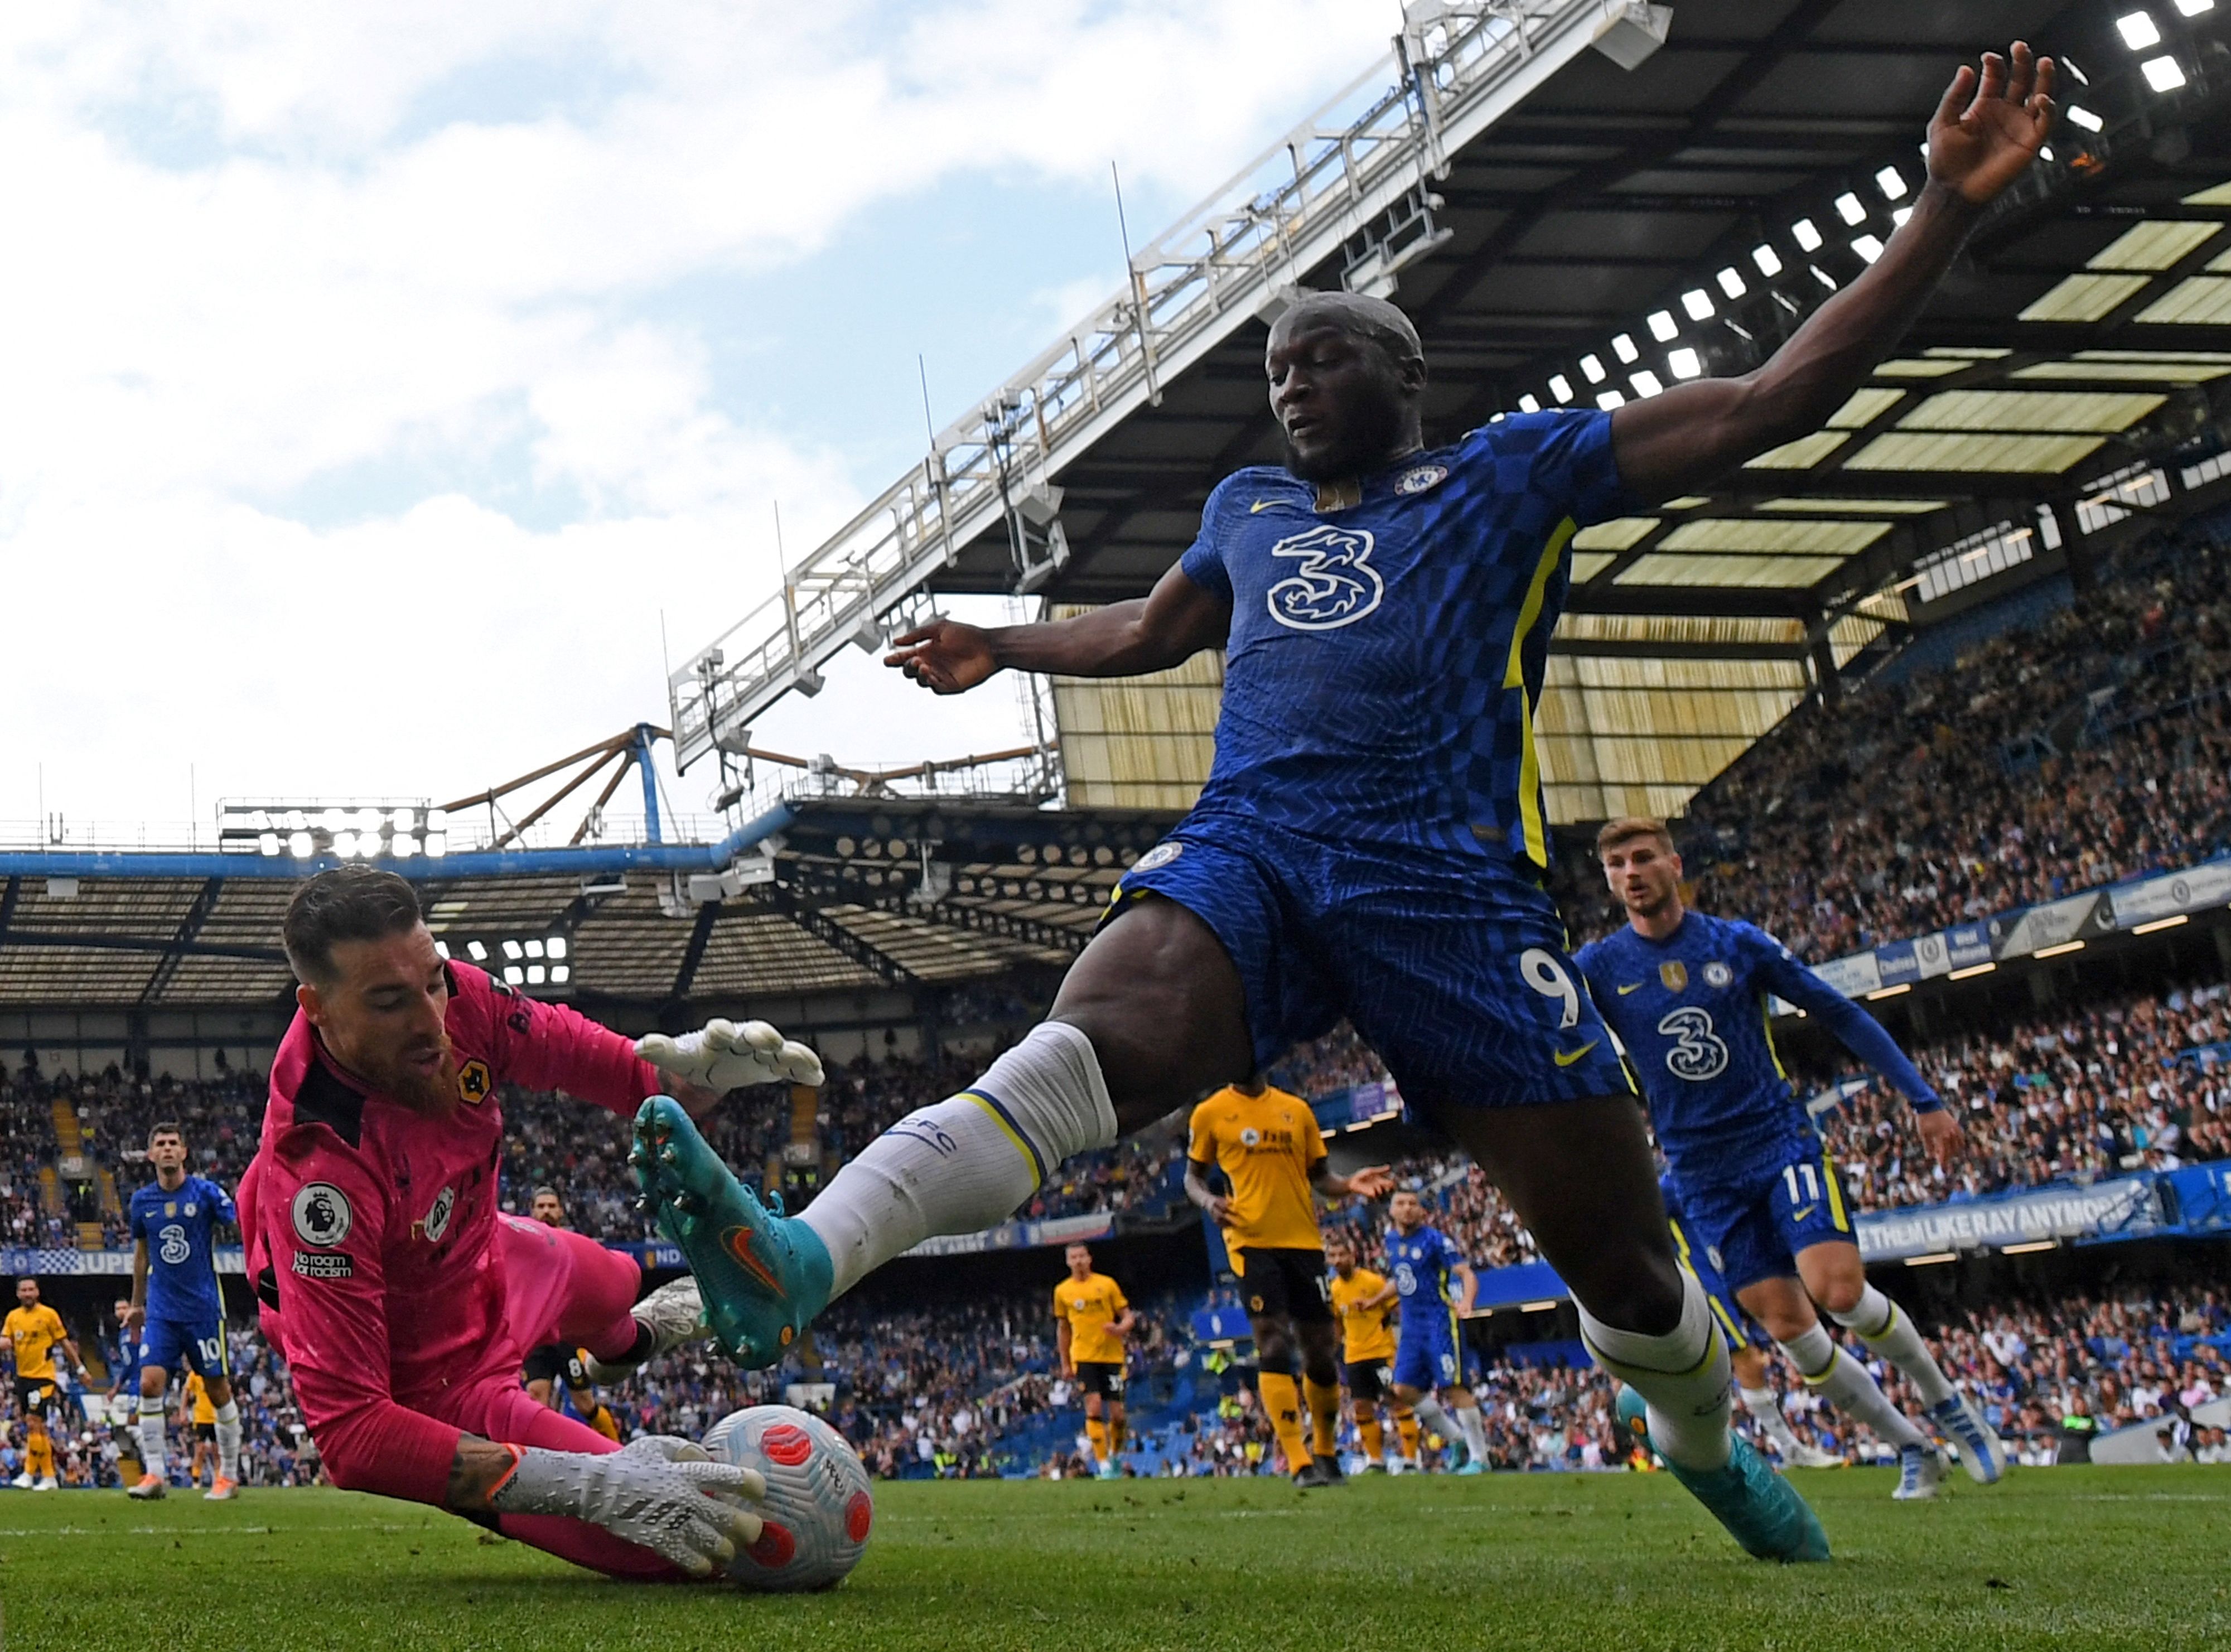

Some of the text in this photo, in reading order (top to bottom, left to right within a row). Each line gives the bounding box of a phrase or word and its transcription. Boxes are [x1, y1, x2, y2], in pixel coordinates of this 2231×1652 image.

[1520, 948, 1579, 1029] 9
[1783, 1163, 1820, 1205] 11
[76, 1253, 134, 1274] SUPE
[293, 1249, 345, 1267] No room
[310, 1267, 351, 1277] racism
[197, 1337, 221, 1361] 10
[568, 1358, 581, 1377] 8
